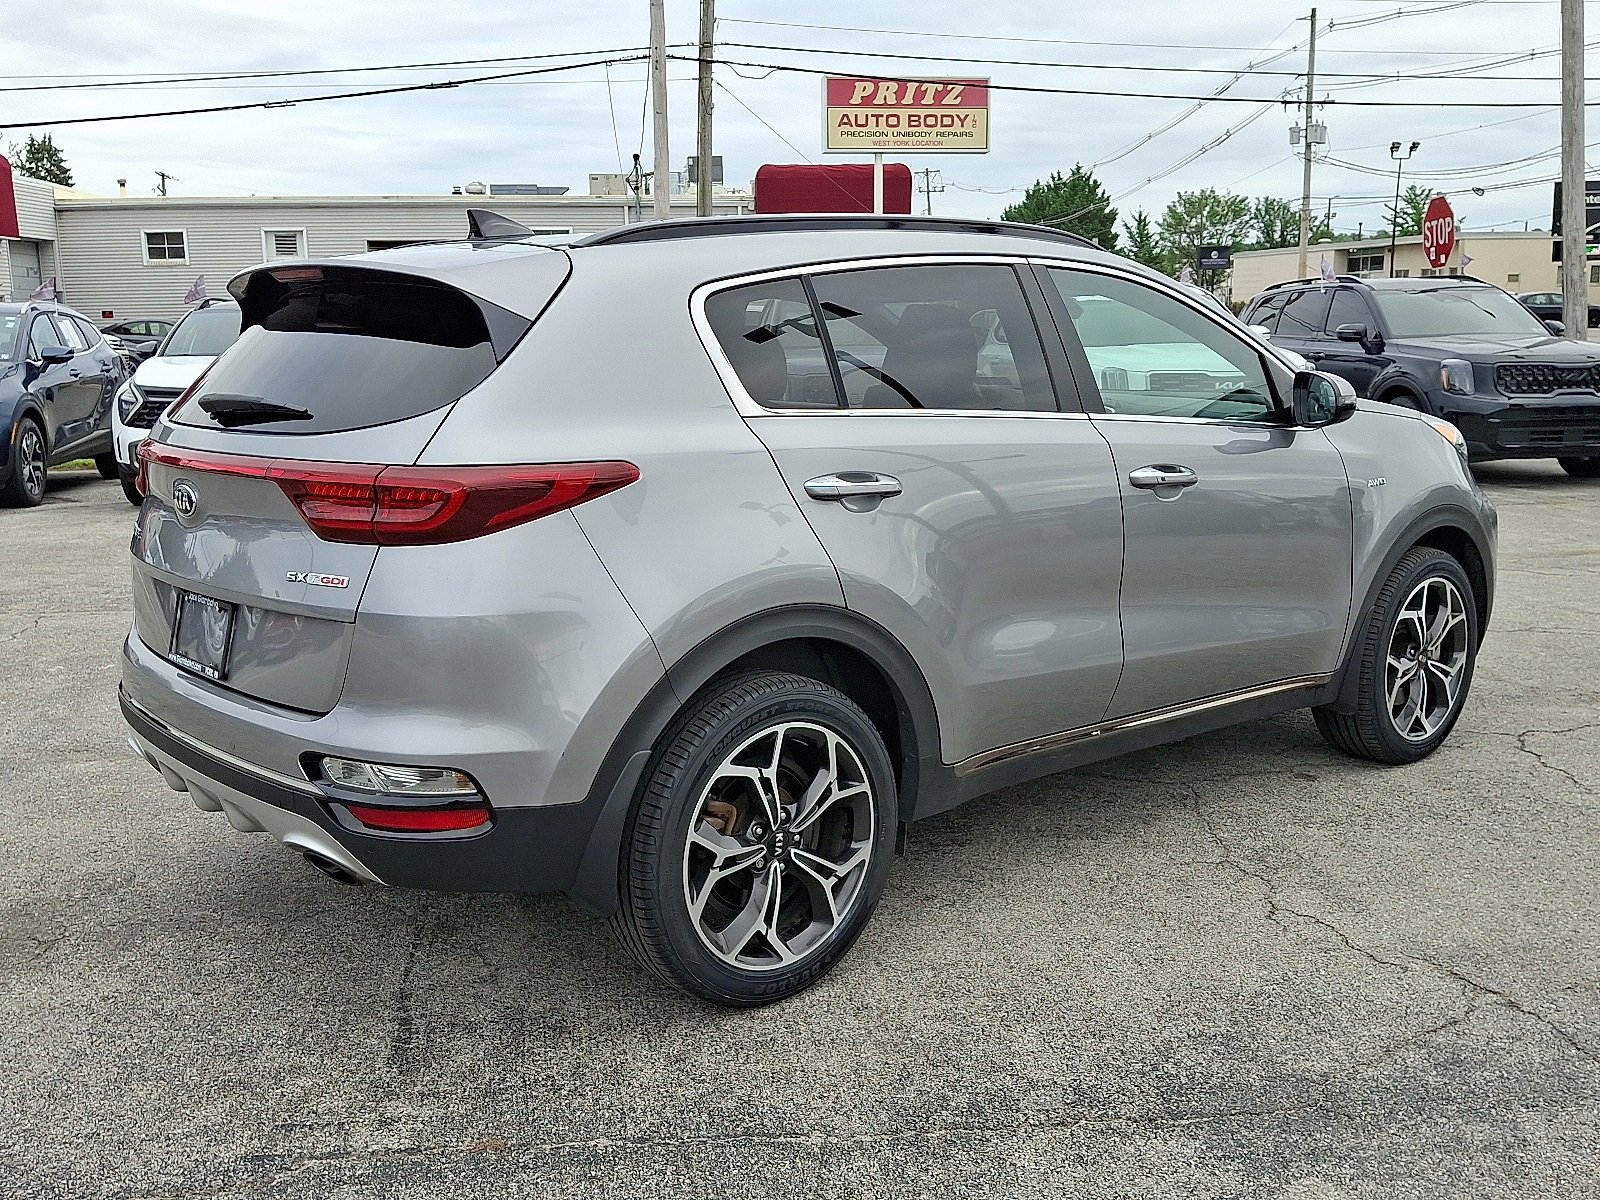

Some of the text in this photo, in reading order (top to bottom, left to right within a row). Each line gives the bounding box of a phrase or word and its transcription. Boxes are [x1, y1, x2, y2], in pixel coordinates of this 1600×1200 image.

[849, 81, 965, 105] PRITZ
[837, 113, 970, 128] AUTO BODY
[1424, 216, 1453, 248] STOP
[1367, 477, 1387, 488] AWD
[775, 832, 784, 856] KIA
